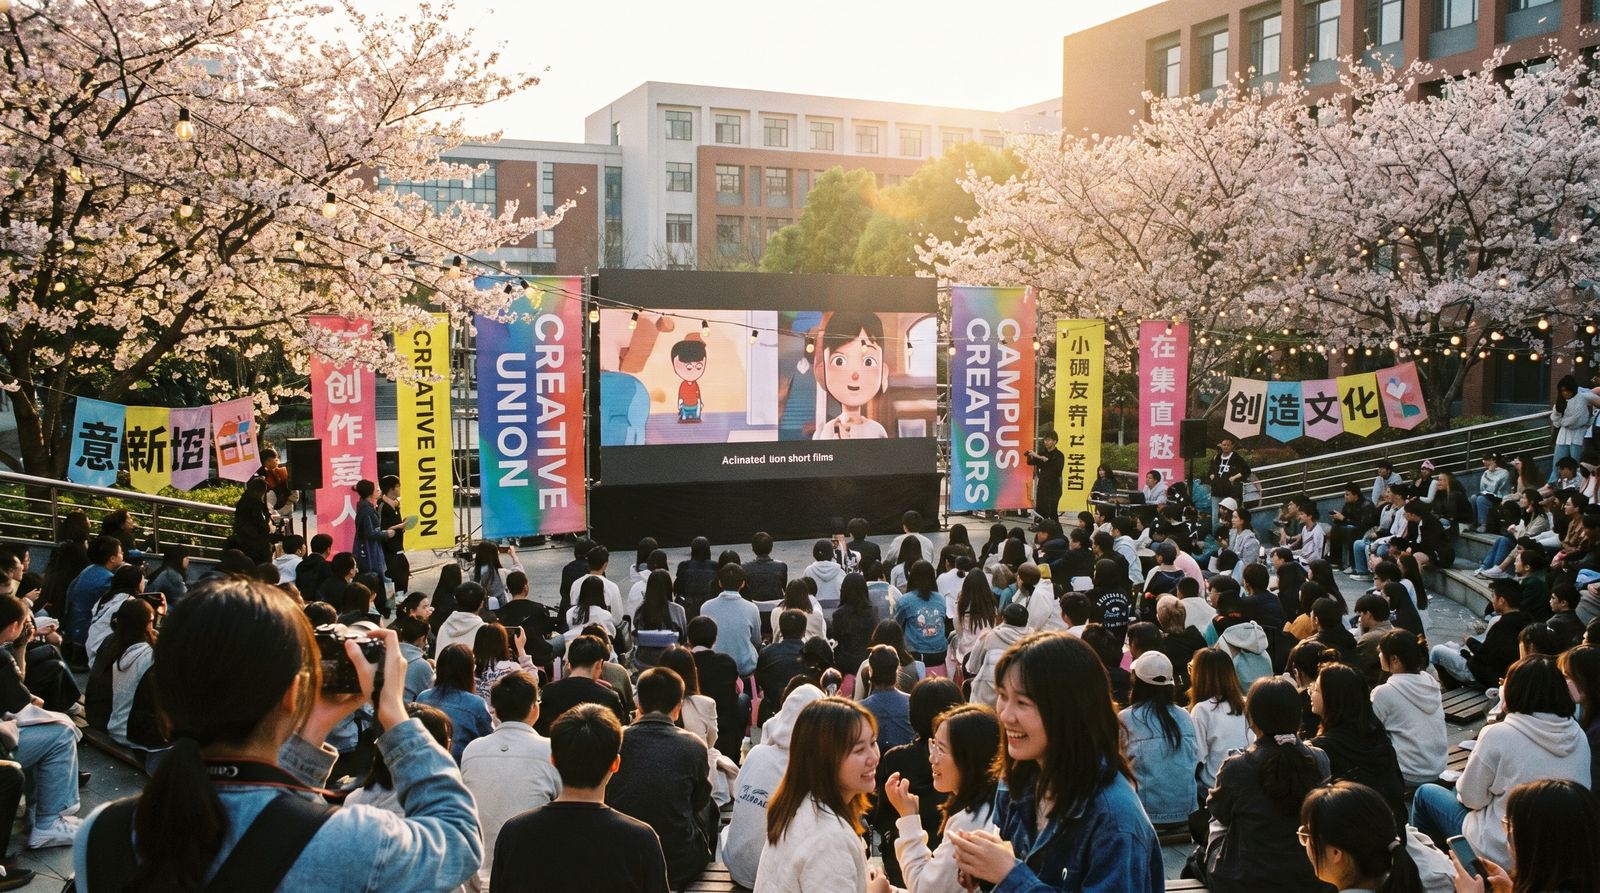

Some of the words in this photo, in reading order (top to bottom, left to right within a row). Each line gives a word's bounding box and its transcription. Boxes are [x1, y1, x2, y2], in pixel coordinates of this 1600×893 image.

[413, 330, 435, 450] CREATIVE
[496, 352, 528, 488] UNION
[534, 313, 567, 510] CREATIVE
[965, 318, 991, 503] CREATORS
[995, 318, 1021, 469] CAMPUS
[1230, 386, 1378, 427] 创造文化
[418, 457, 438, 537] UNION
[788, 453, 811, 463] short
[813, 453, 834, 462] films
